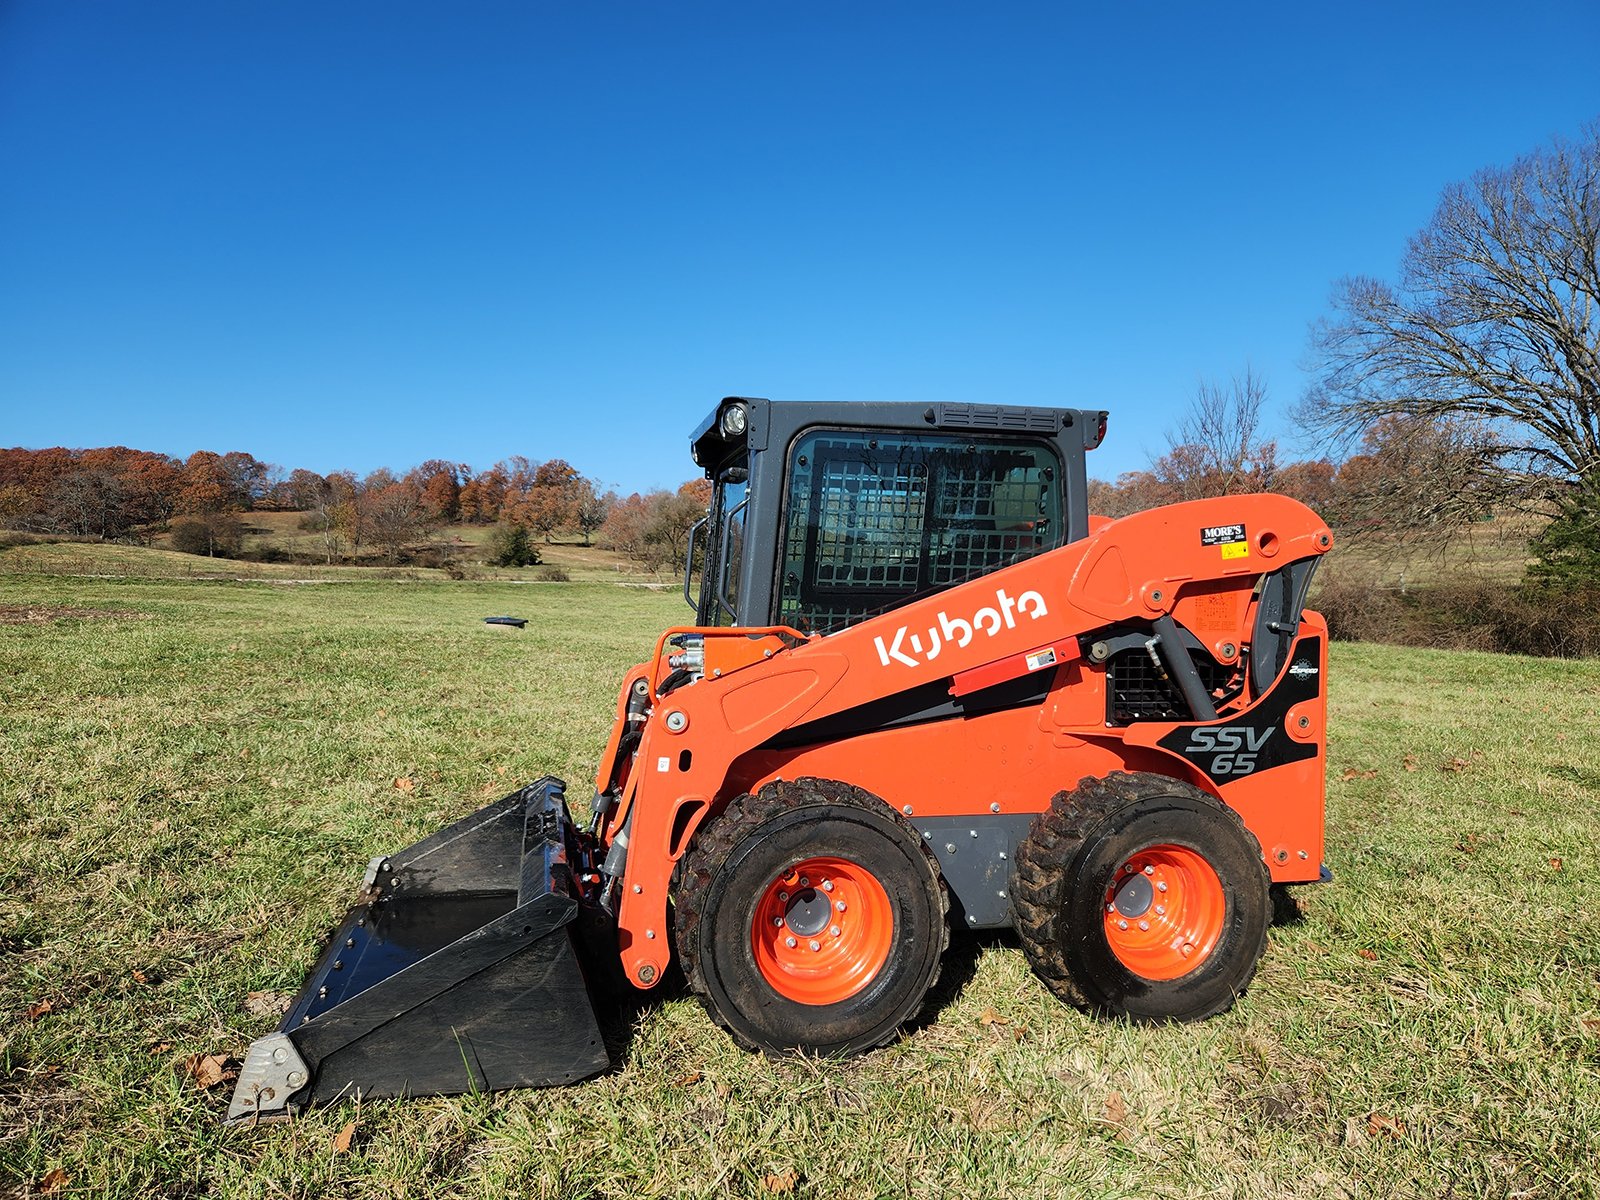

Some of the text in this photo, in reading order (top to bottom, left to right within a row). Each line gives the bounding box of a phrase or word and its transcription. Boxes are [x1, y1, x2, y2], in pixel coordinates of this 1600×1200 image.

[1204, 525, 1242, 538] MORE'S
[873, 589, 1048, 668] Kubota
[1185, 727, 1276, 752] SSV
[1211, 754, 1257, 774] 65
